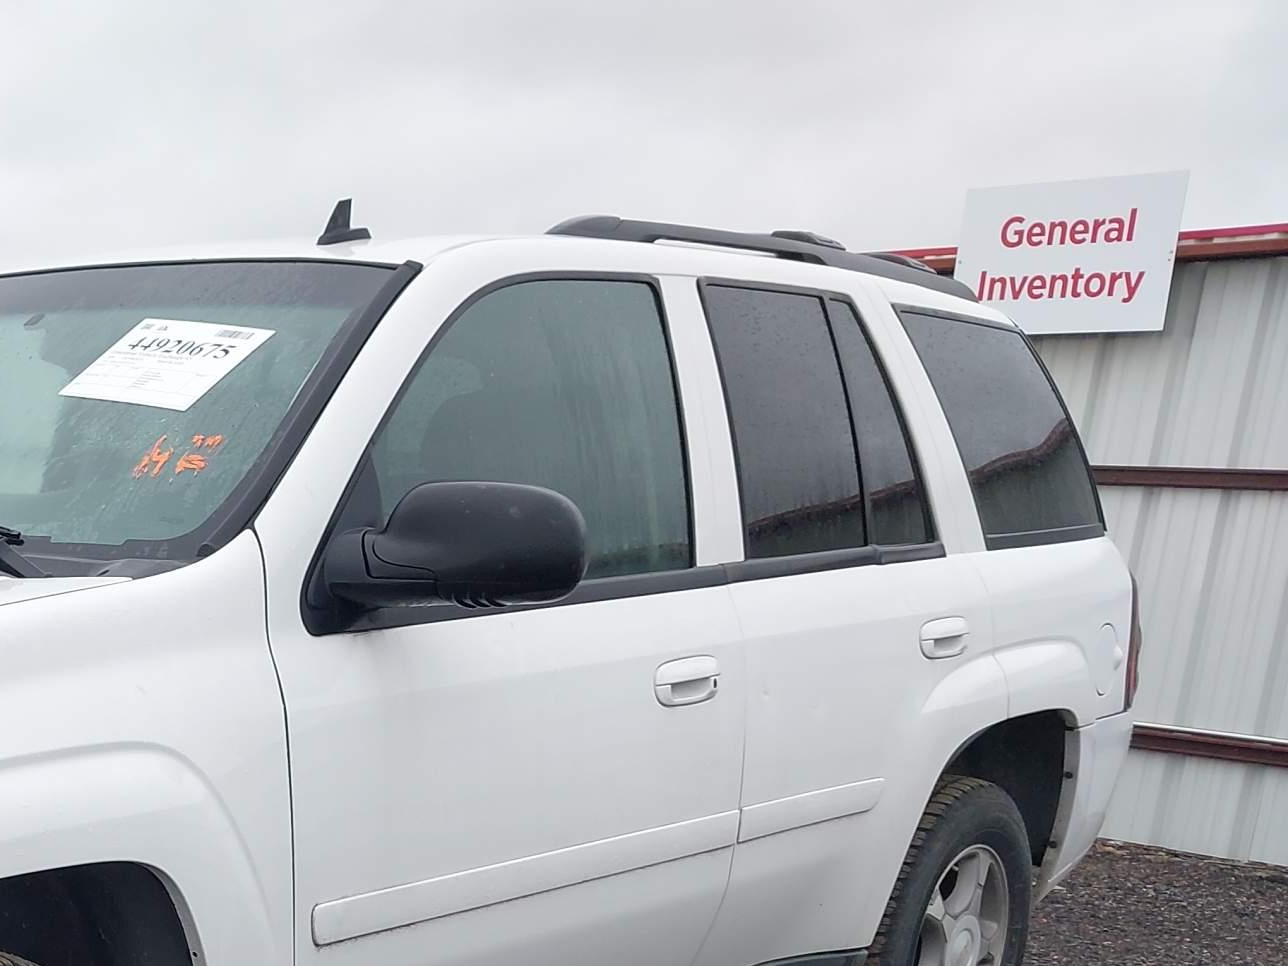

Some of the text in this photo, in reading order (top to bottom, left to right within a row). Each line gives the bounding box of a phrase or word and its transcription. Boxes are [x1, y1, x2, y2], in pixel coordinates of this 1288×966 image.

[1000, 208, 1138, 248] General
[977, 267, 1146, 304] Inventory
[128, 336, 236, 359] 44920675
